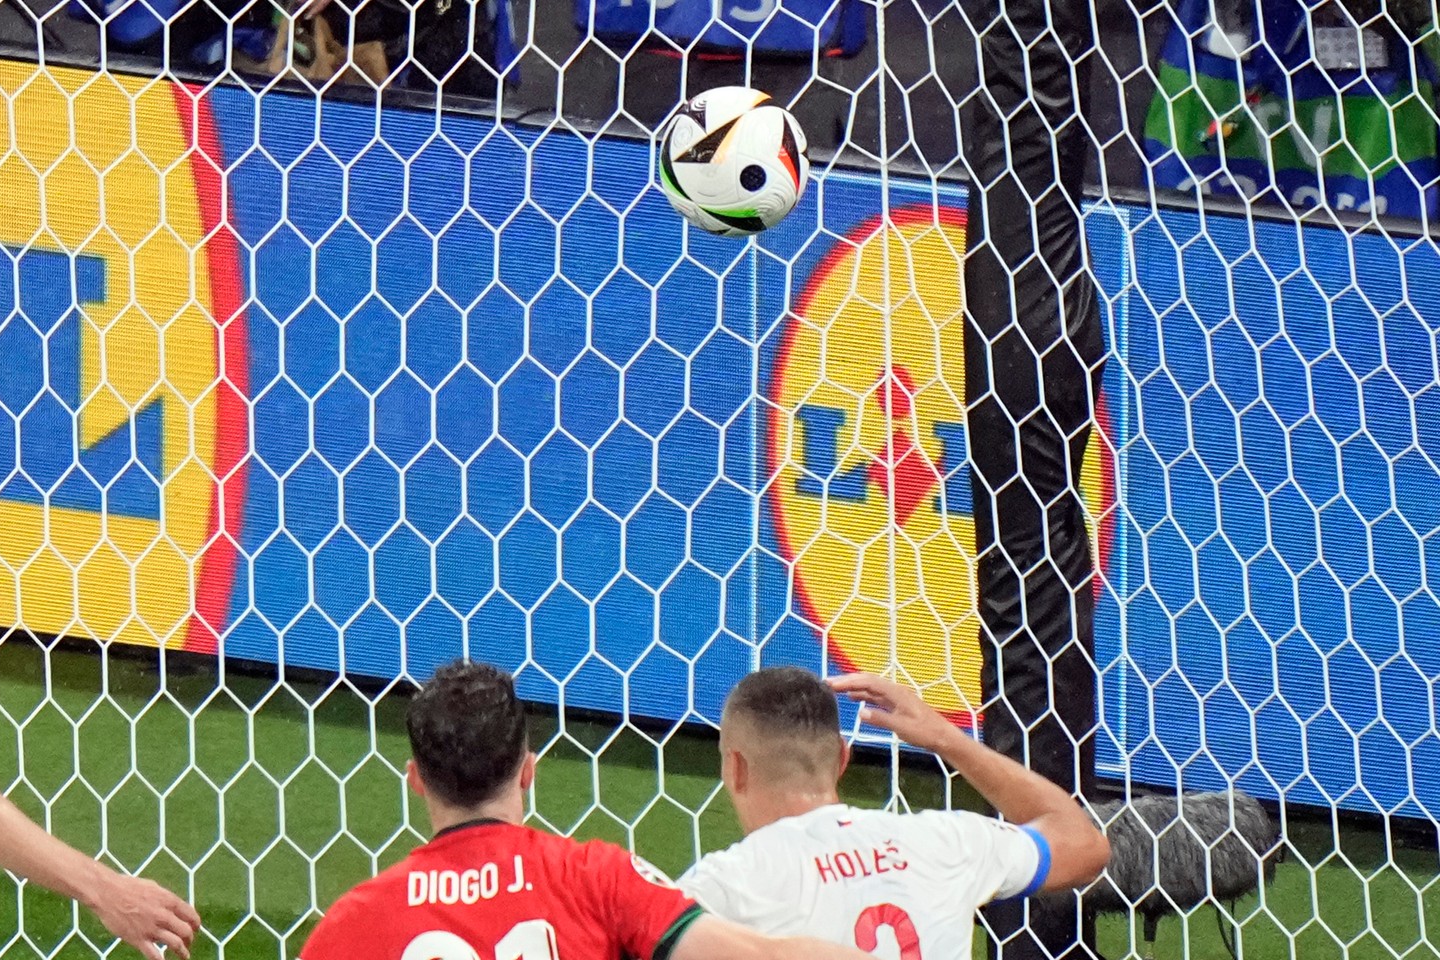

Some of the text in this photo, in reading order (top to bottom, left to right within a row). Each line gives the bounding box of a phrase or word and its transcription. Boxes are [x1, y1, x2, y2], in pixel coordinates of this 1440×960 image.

[407, 855, 533, 907] DIOGO J.
[814, 838, 908, 884] HOLEŠ
